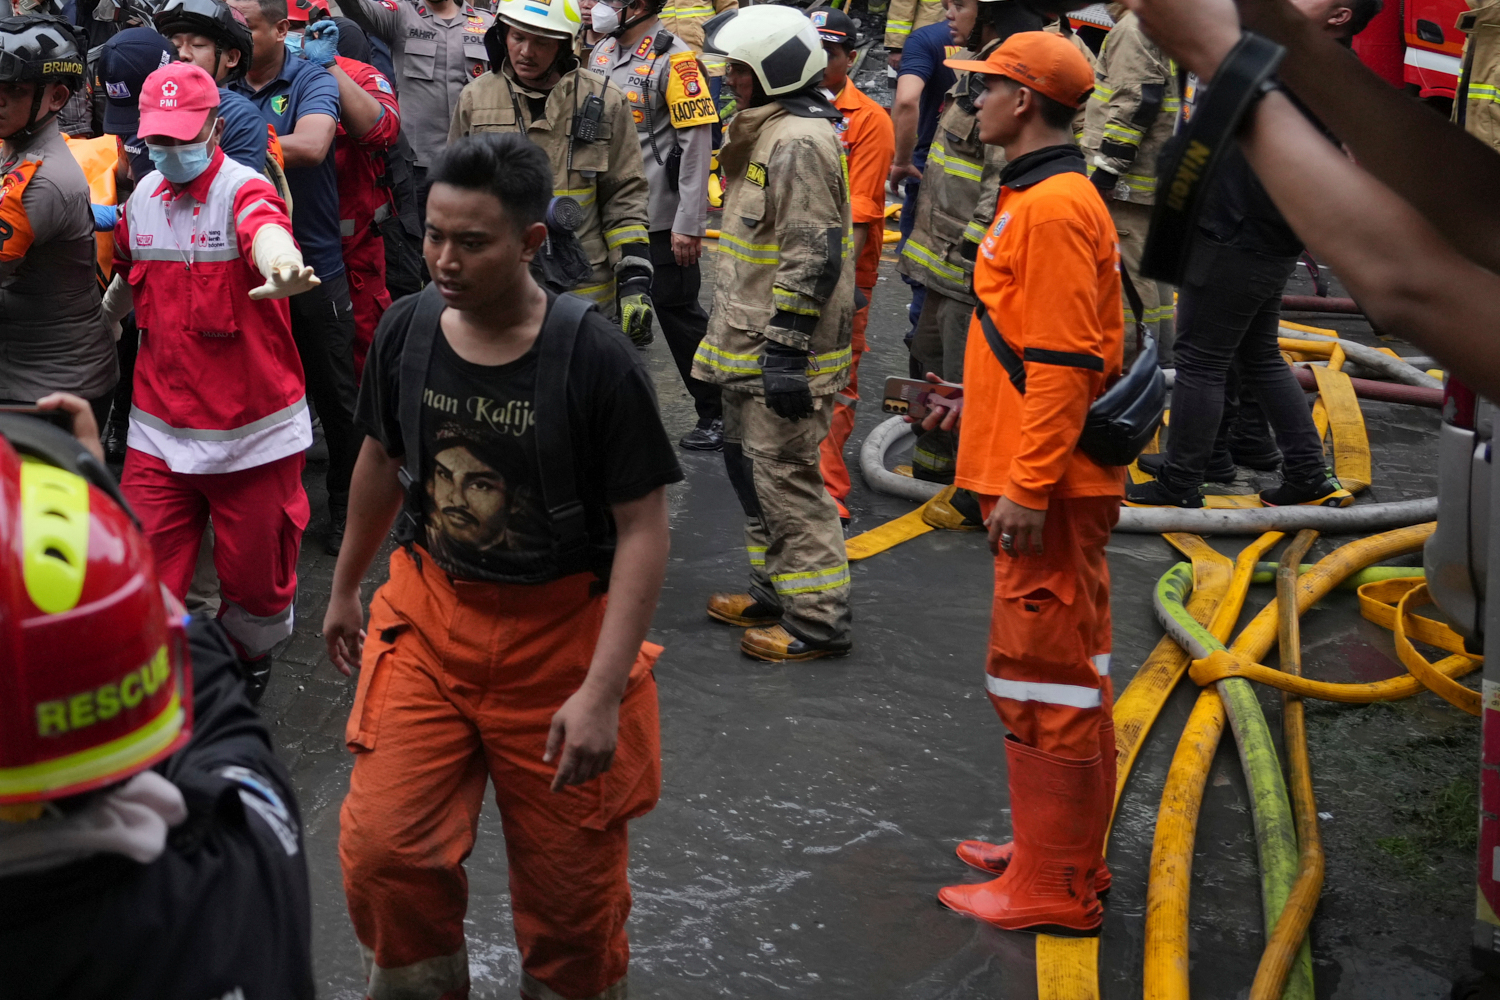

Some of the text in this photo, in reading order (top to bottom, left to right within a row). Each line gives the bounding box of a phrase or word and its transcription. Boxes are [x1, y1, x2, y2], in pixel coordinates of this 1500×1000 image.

[409, 28, 437, 40] FAHRY
[43, 61, 83, 75] BRIMOB
[160, 99, 177, 107] PMI
[423, 388, 458, 414] nan
[36, 644, 171, 737] RESCUE
